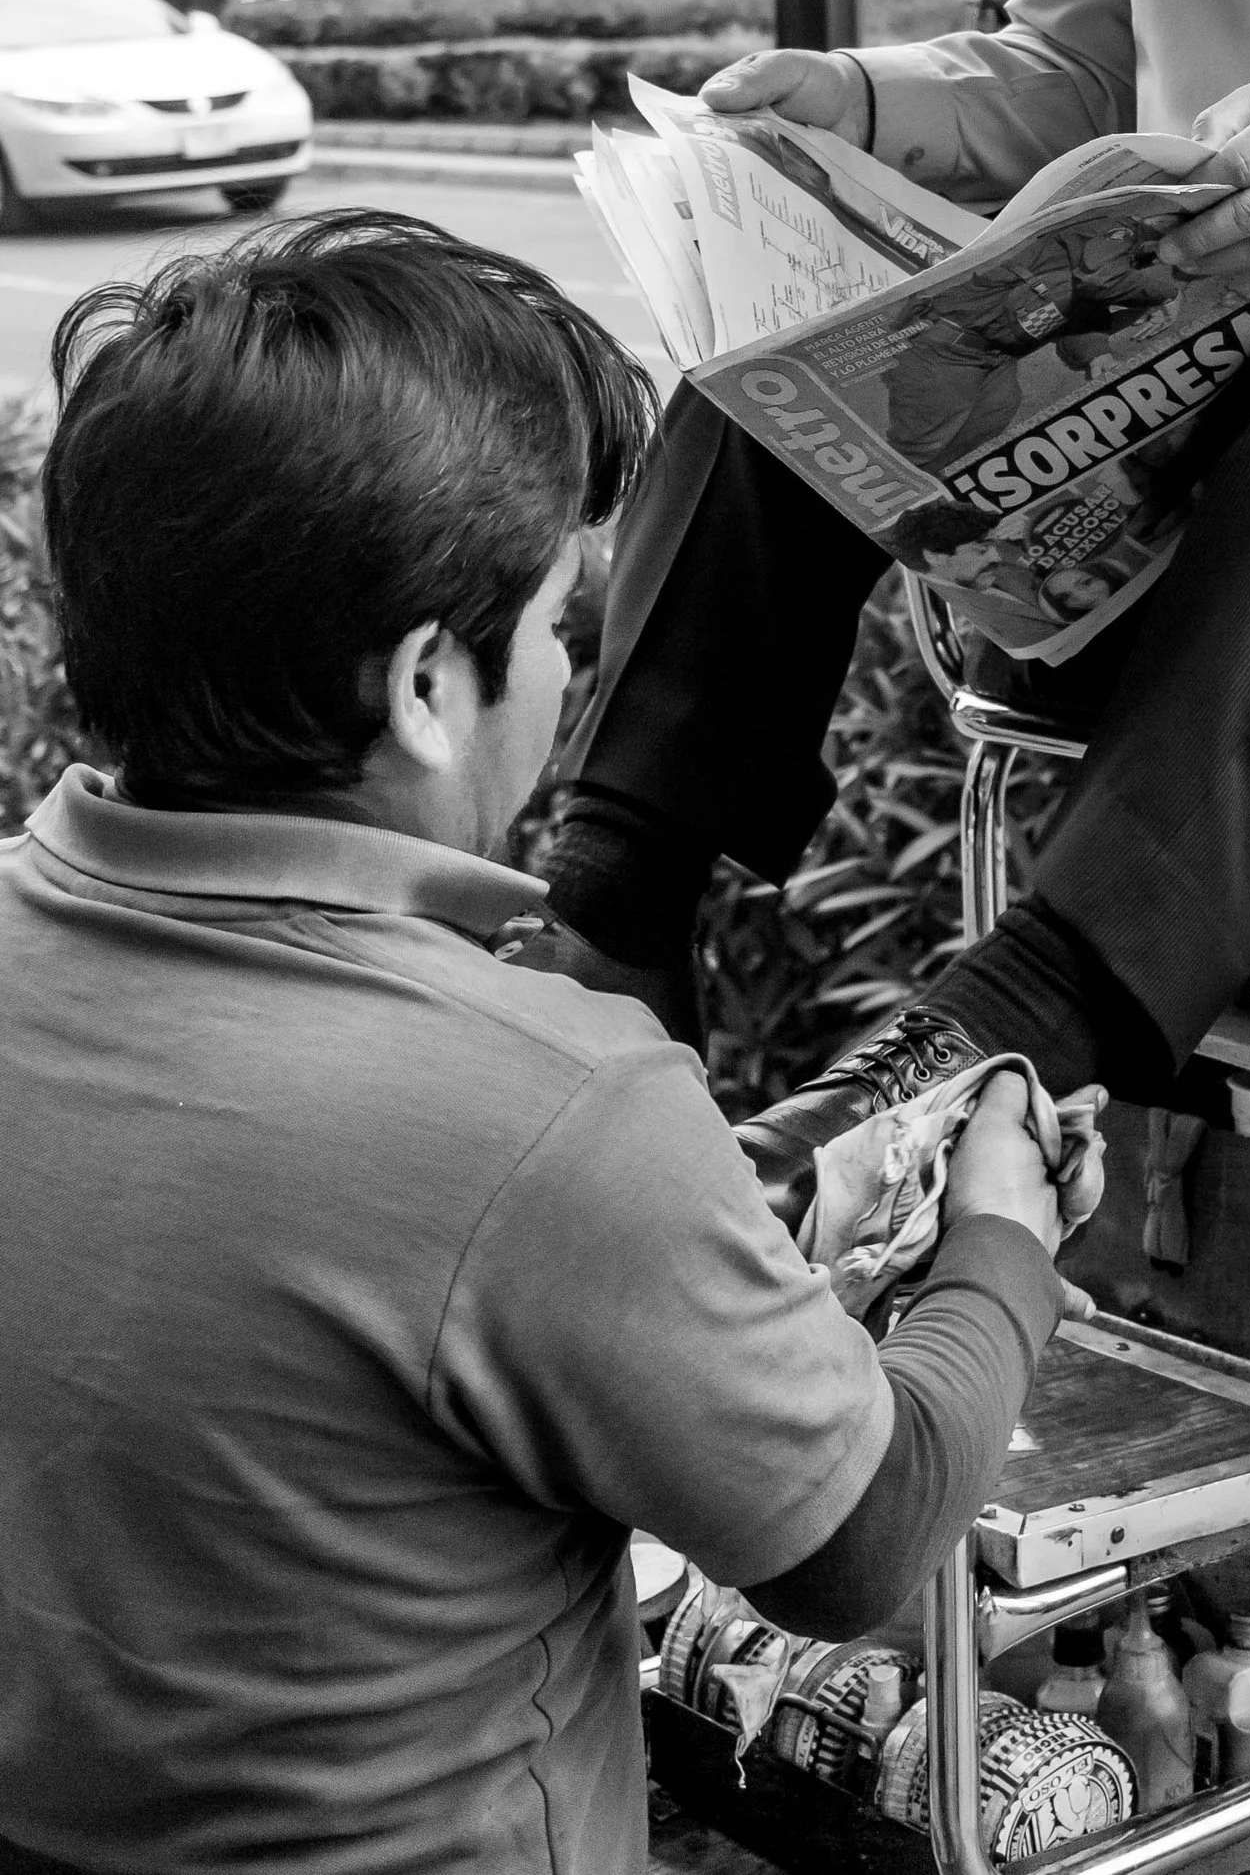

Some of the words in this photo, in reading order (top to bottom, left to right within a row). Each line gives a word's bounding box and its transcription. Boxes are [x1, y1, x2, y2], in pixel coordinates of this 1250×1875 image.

[804, 331, 845, 352] MARCA
[844, 313, 888, 336] AGENTE
[813, 347, 828, 361] EL
[828, 338, 856, 356] ALTO
[855, 327, 888, 347] PARA
[873, 337, 887, 351] DE
[887, 321, 930, 343] RUTINA
[829, 369, 840, 379] Y
[839, 362, 857, 376] LO
[856, 343, 909, 369] PLOMEAN
[740, 368, 921, 517] metro
[1019, 545, 1045, 566] LO
[1042, 484, 1113, 546] ACUSAN
[1037, 547, 1066, 569] DE
[1063, 498, 1120, 549] ACOSO
[1061, 514, 1128, 568] SEXUAL
[1023, 1731, 1070, 1762] NEGRO
[1065, 1757, 1089, 1777] EL
[1029, 1775, 1062, 1802] OSO
